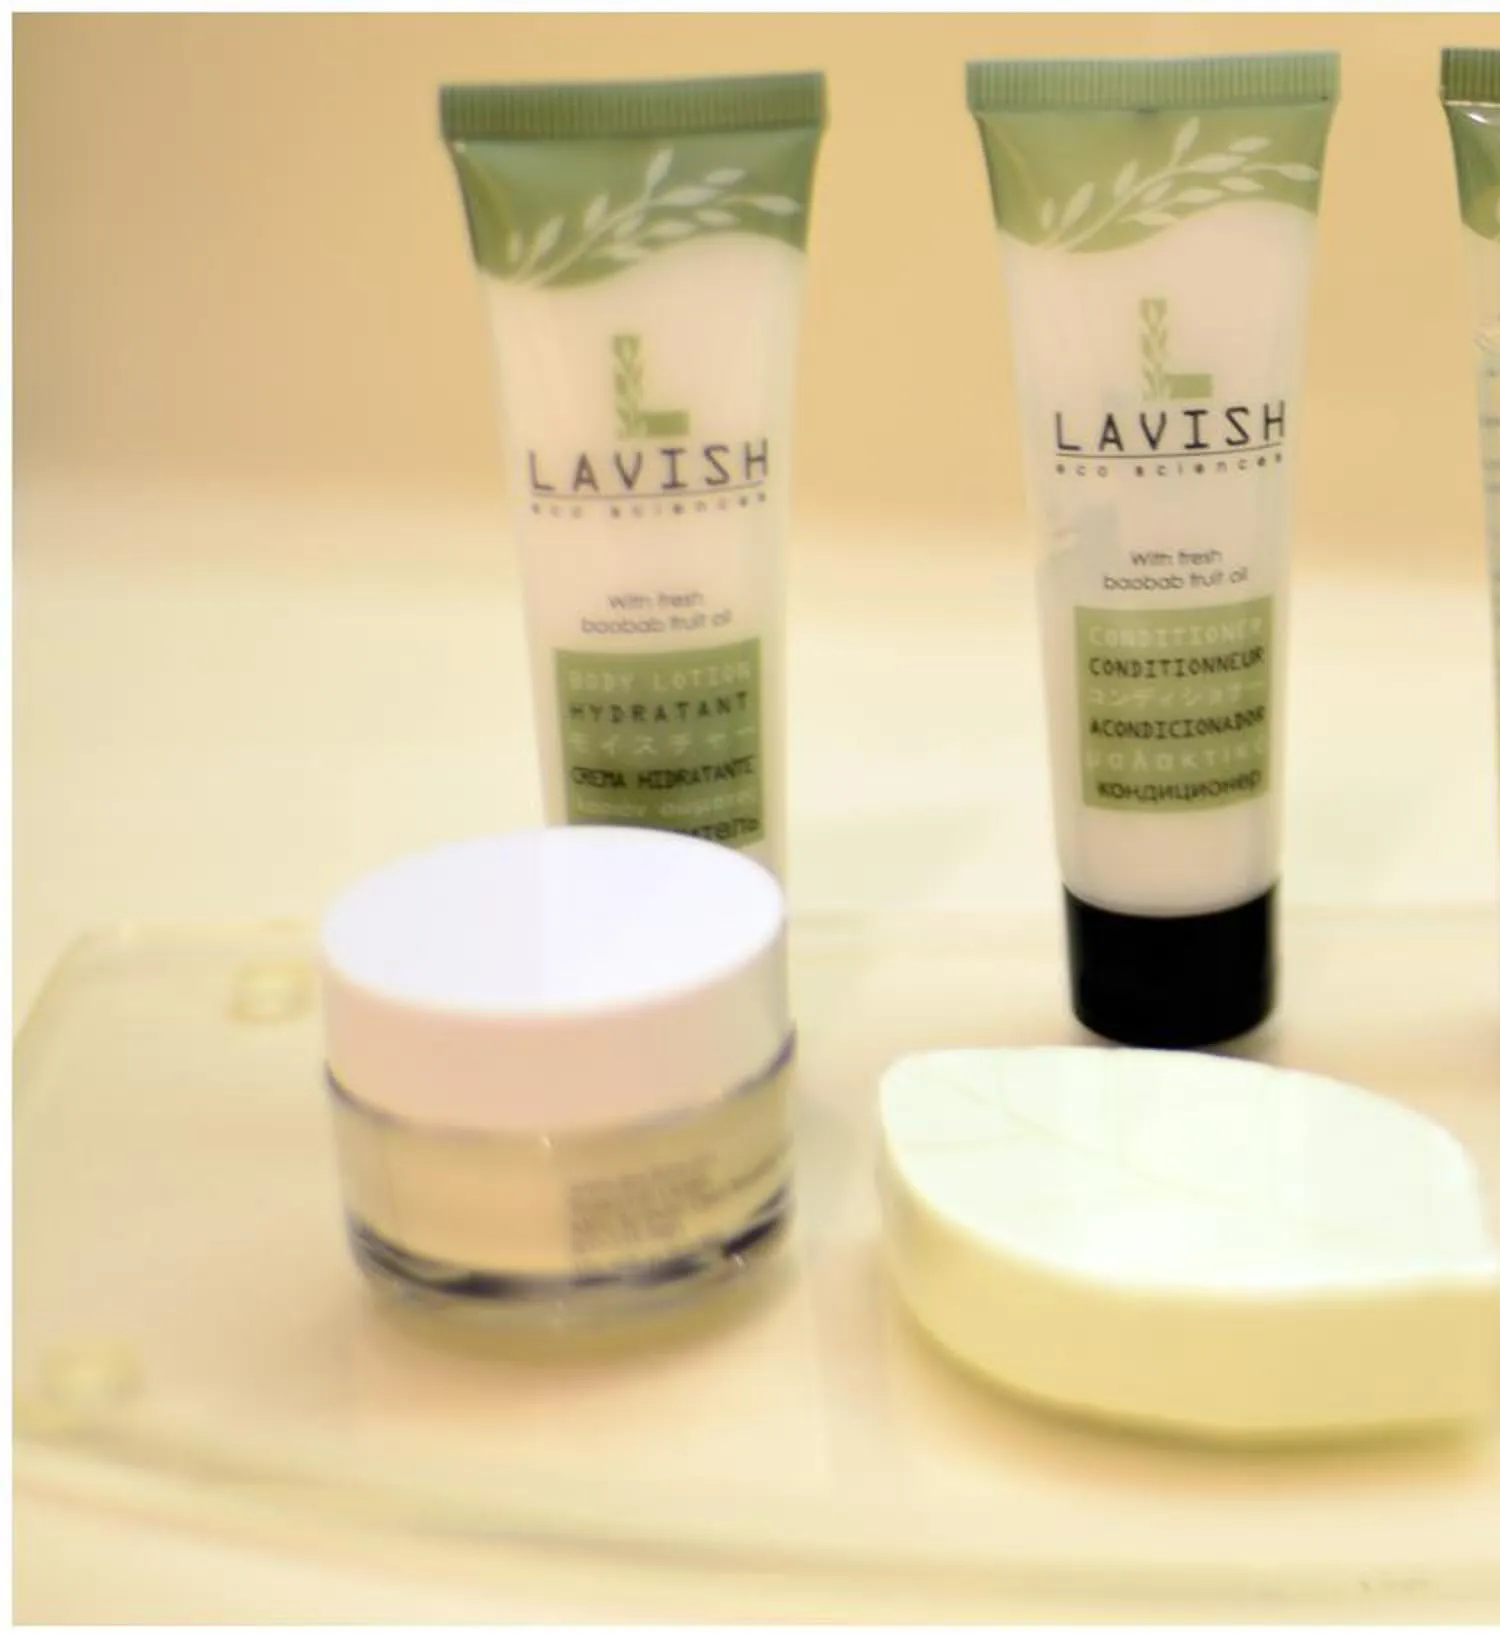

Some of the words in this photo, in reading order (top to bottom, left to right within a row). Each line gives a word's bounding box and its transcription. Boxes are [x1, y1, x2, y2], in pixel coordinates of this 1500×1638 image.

[1055, 401, 1285, 452] LAVISH
[528, 438, 768, 492] LAVISH
[1129, 550, 1174, 567] With
[1176, 549, 1223, 566] fresh
[1103, 574, 1185, 590] baobab
[1088, 645, 1266, 680] CONDITIONNEUR
[567, 690, 749, 725] HYDRATANT
[1089, 705, 1266, 740] ACONDICIONADOR
[571, 765, 629, 790] CREMA
[636, 754, 758, 790] HIDRATANTE
